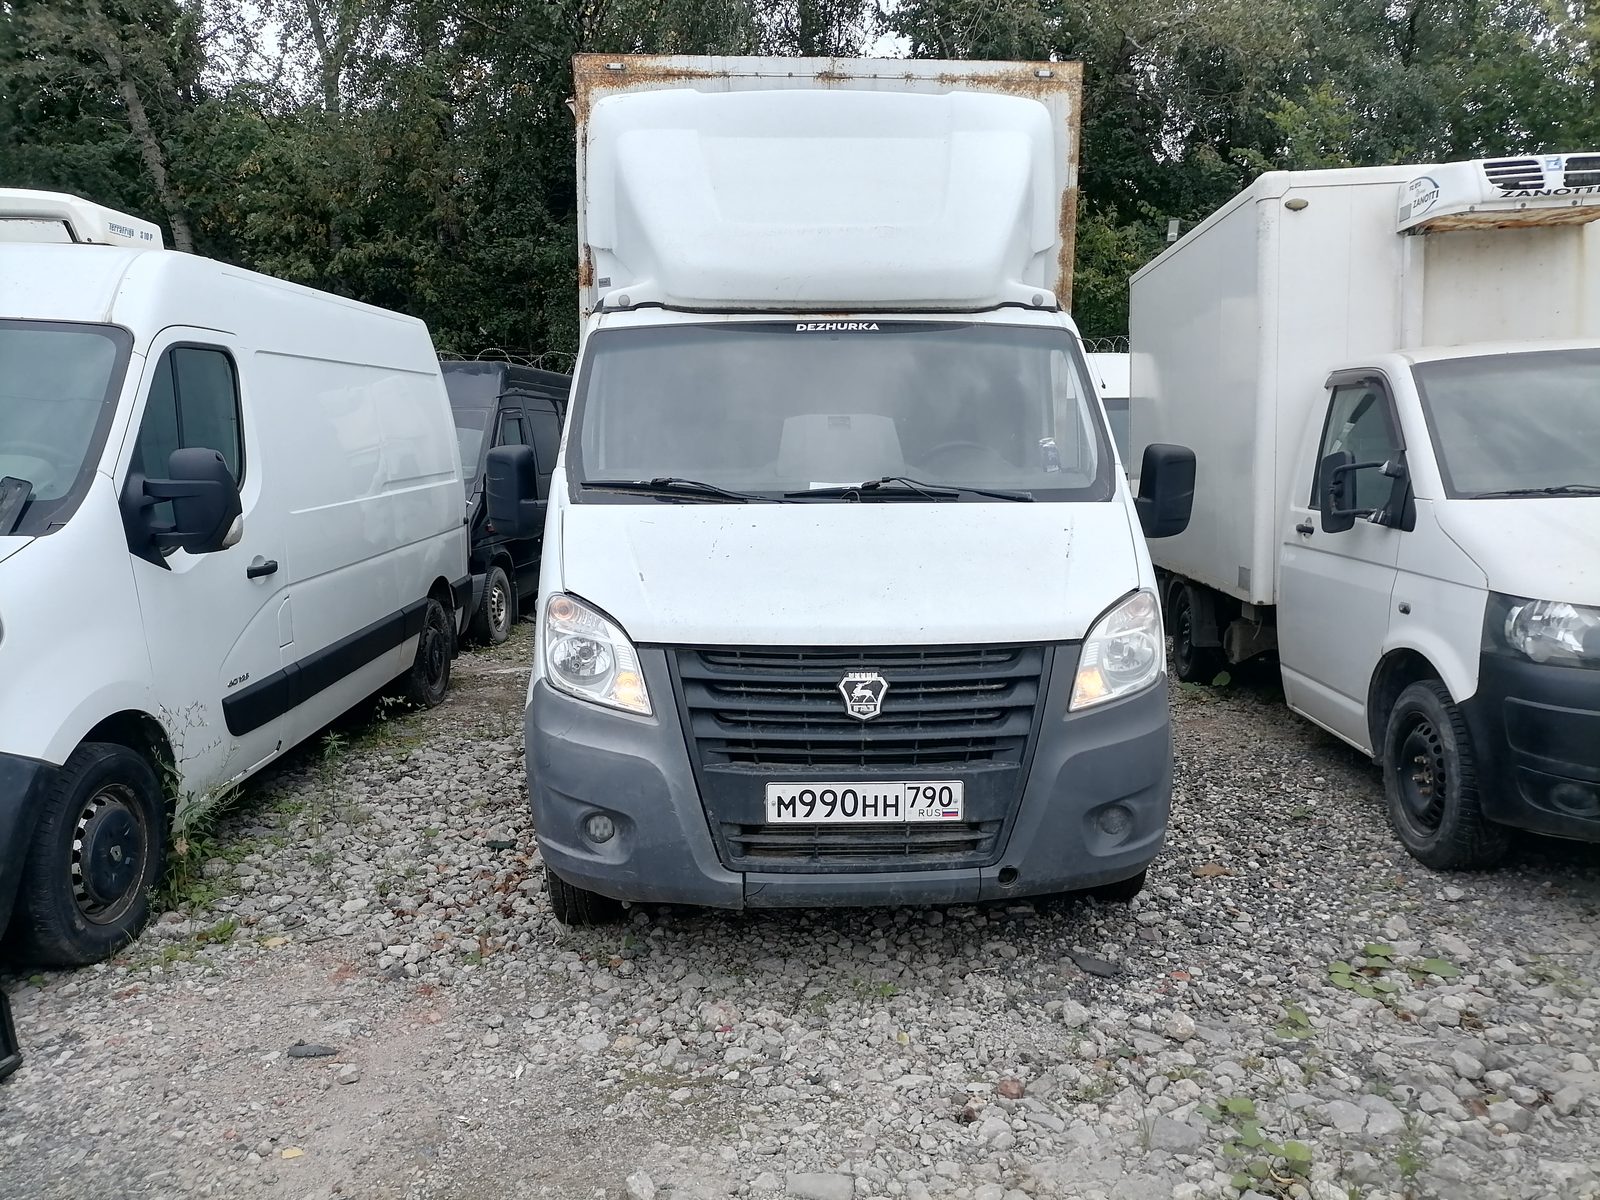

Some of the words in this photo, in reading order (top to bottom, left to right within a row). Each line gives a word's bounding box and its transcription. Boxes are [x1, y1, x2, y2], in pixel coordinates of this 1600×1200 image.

[1413, 189, 1439, 209] ZANOTTI
[796, 322, 880, 332] DEZHURKA
[907, 786, 954, 808] 790
[918, 808, 941, 817] RUS
